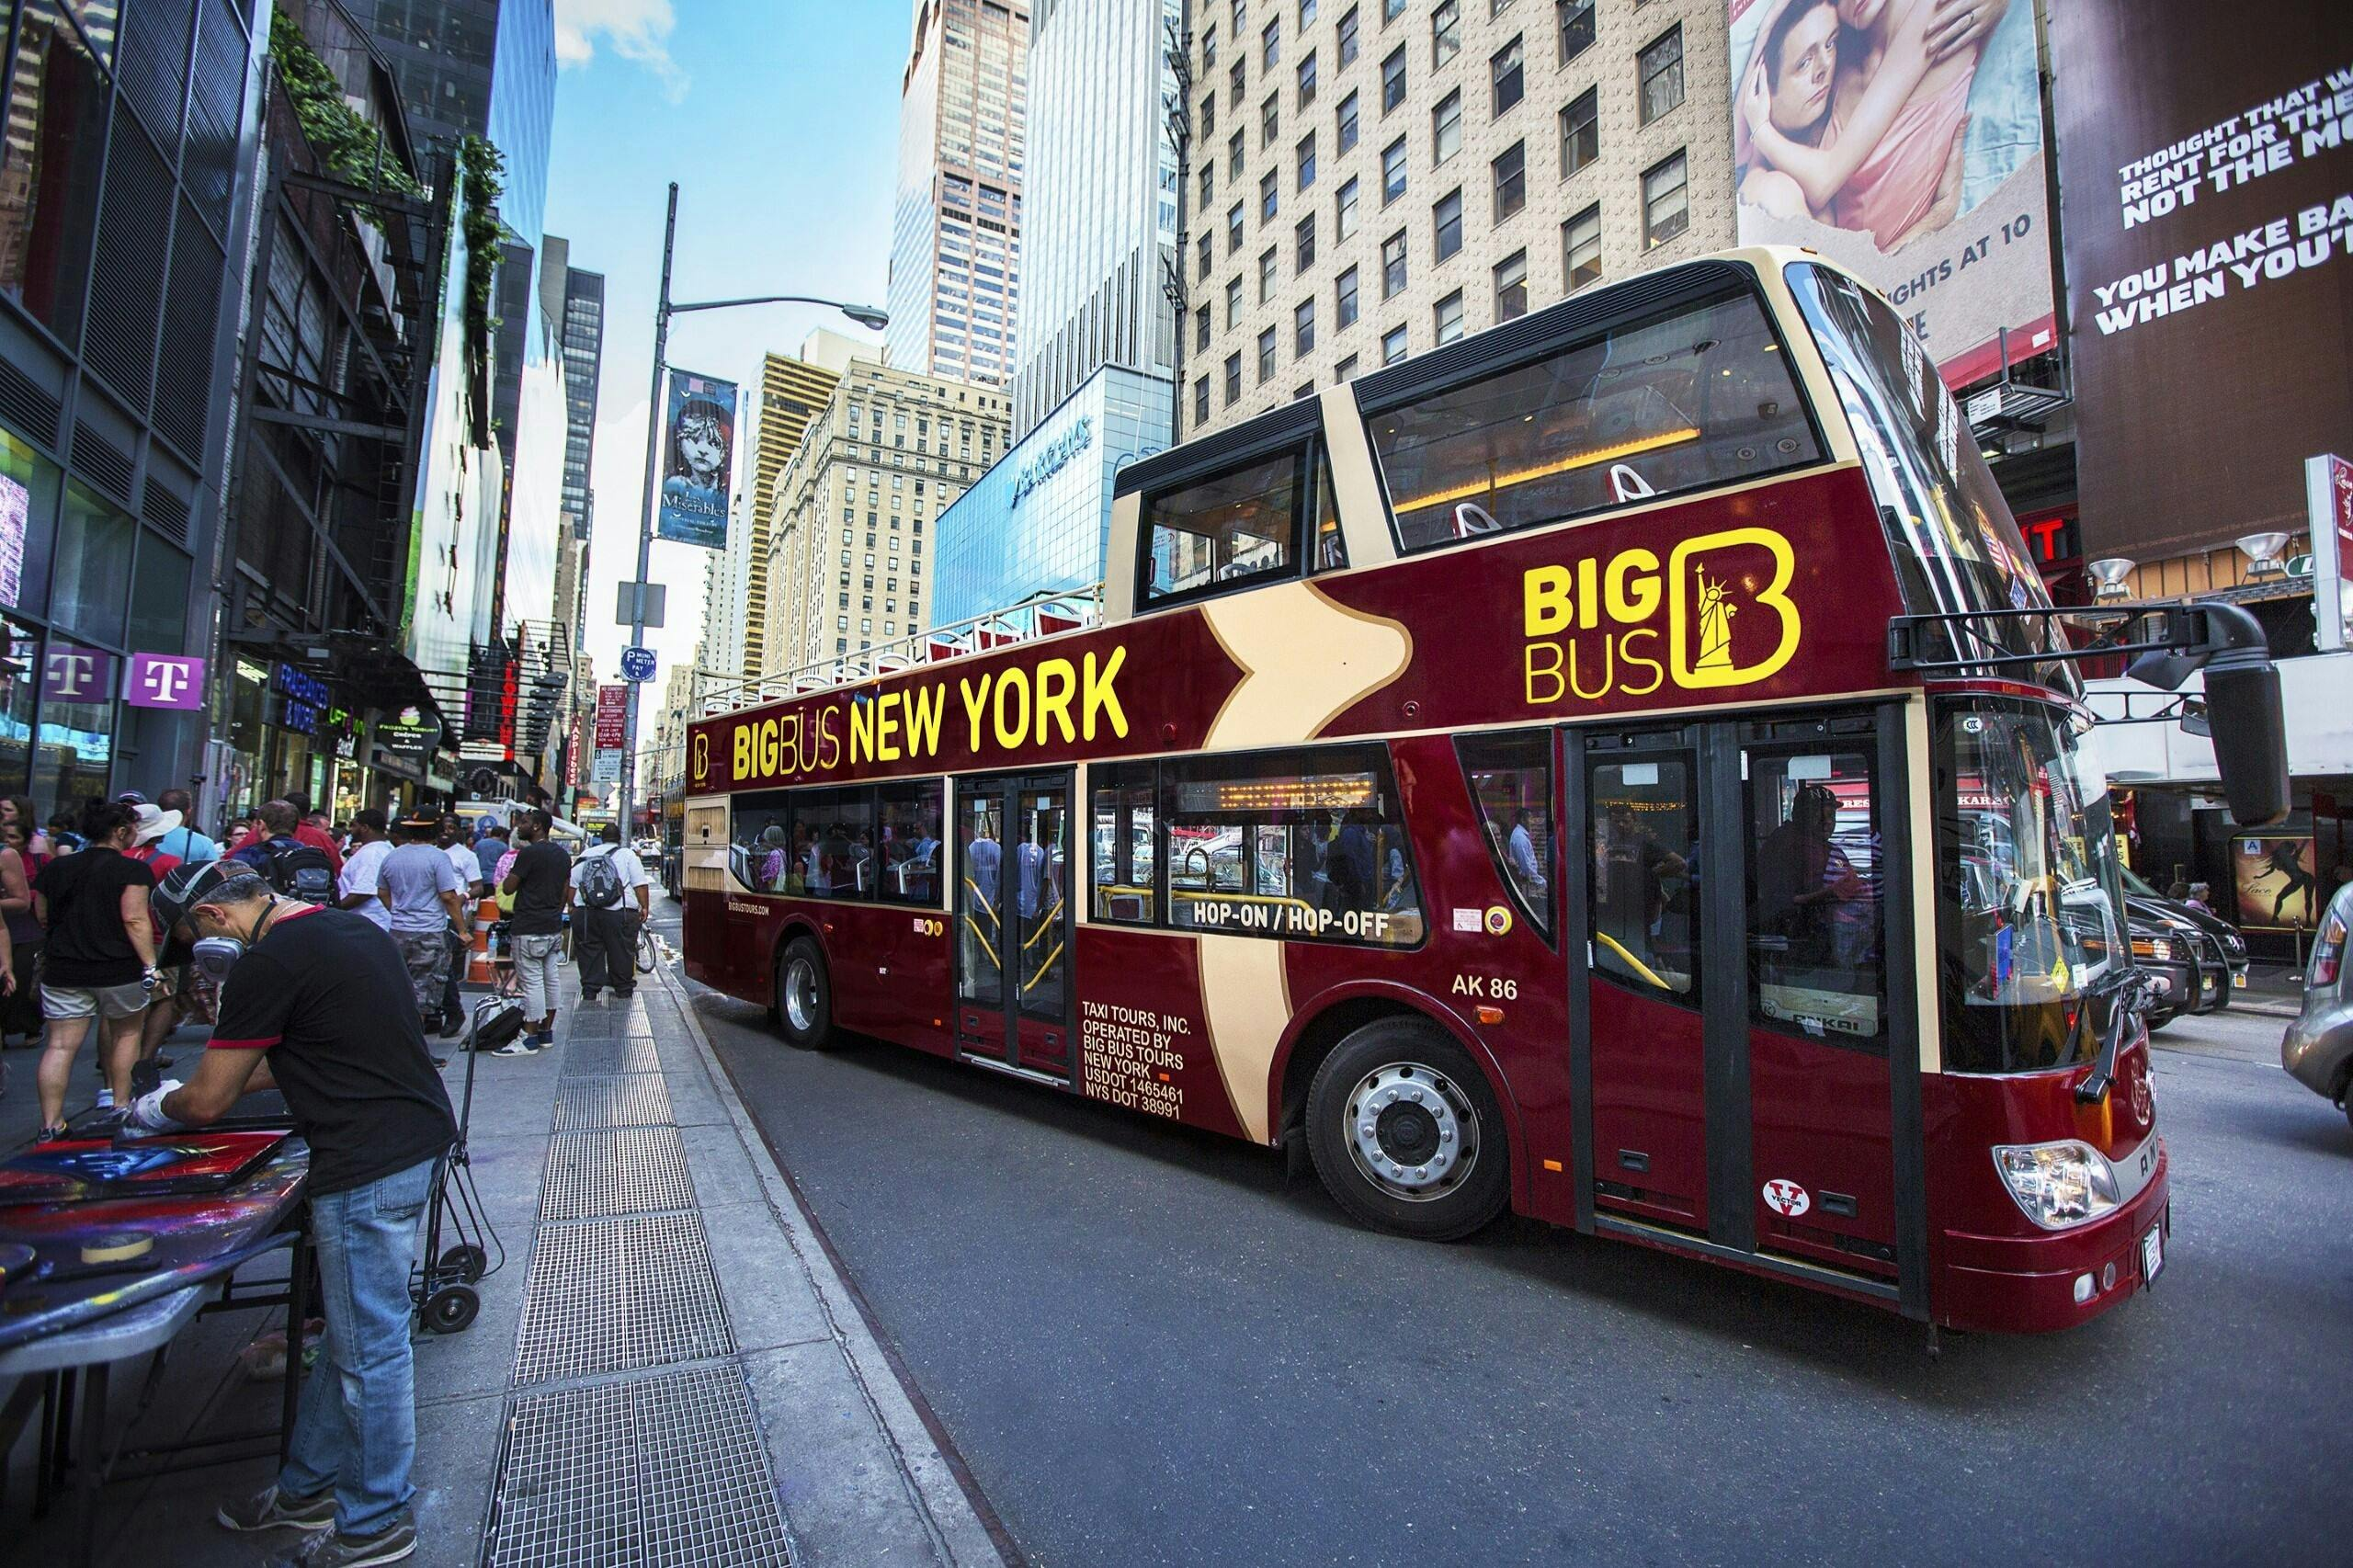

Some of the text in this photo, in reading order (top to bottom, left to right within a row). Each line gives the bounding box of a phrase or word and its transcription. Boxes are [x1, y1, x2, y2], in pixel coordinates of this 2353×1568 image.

[2119, 117, 2240, 182] THOUGHT
[2244, 81, 2321, 127] THAT
[2120, 152, 2204, 205] RENT
[2209, 123, 2277, 167] FOR
[2122, 176, 2201, 230] NOT
[2207, 139, 2293, 193] THE
[1960, 235, 1990, 270] AT
[2001, 214, 2031, 245] 10
[2093, 263, 2166, 307] YOU
[2175, 217, 2290, 280] MAKE
[2095, 270, 2225, 336] WHEN
[1524, 548, 1662, 638] BIG
[636, 658, 655, 666] METER
[1525, 628, 1664, 704] BUS
[849, 682, 946, 765] NEW
[960, 645, 1130, 754] YORK
[2247, 841, 2257, 850] A
[1194, 902, 1390, 937] HOP-ON / HOP-OFF
[1451, 973, 1518, 1000] AK 86
[1082, 1000, 1191, 1035] TAXI TOURS, INC.
[1083, 1019, 1171, 1051] OPERATED BY
[1084, 1035, 1184, 1071] BIG BUS TOURS
[1085, 1050, 1151, 1080] NEW YORK
[1085, 1065, 1183, 1105] USDOT 1465461
[1086, 1081, 1180, 1120] NYS DOT 38991
[1771, 1194, 1802, 1208] VECTOR
